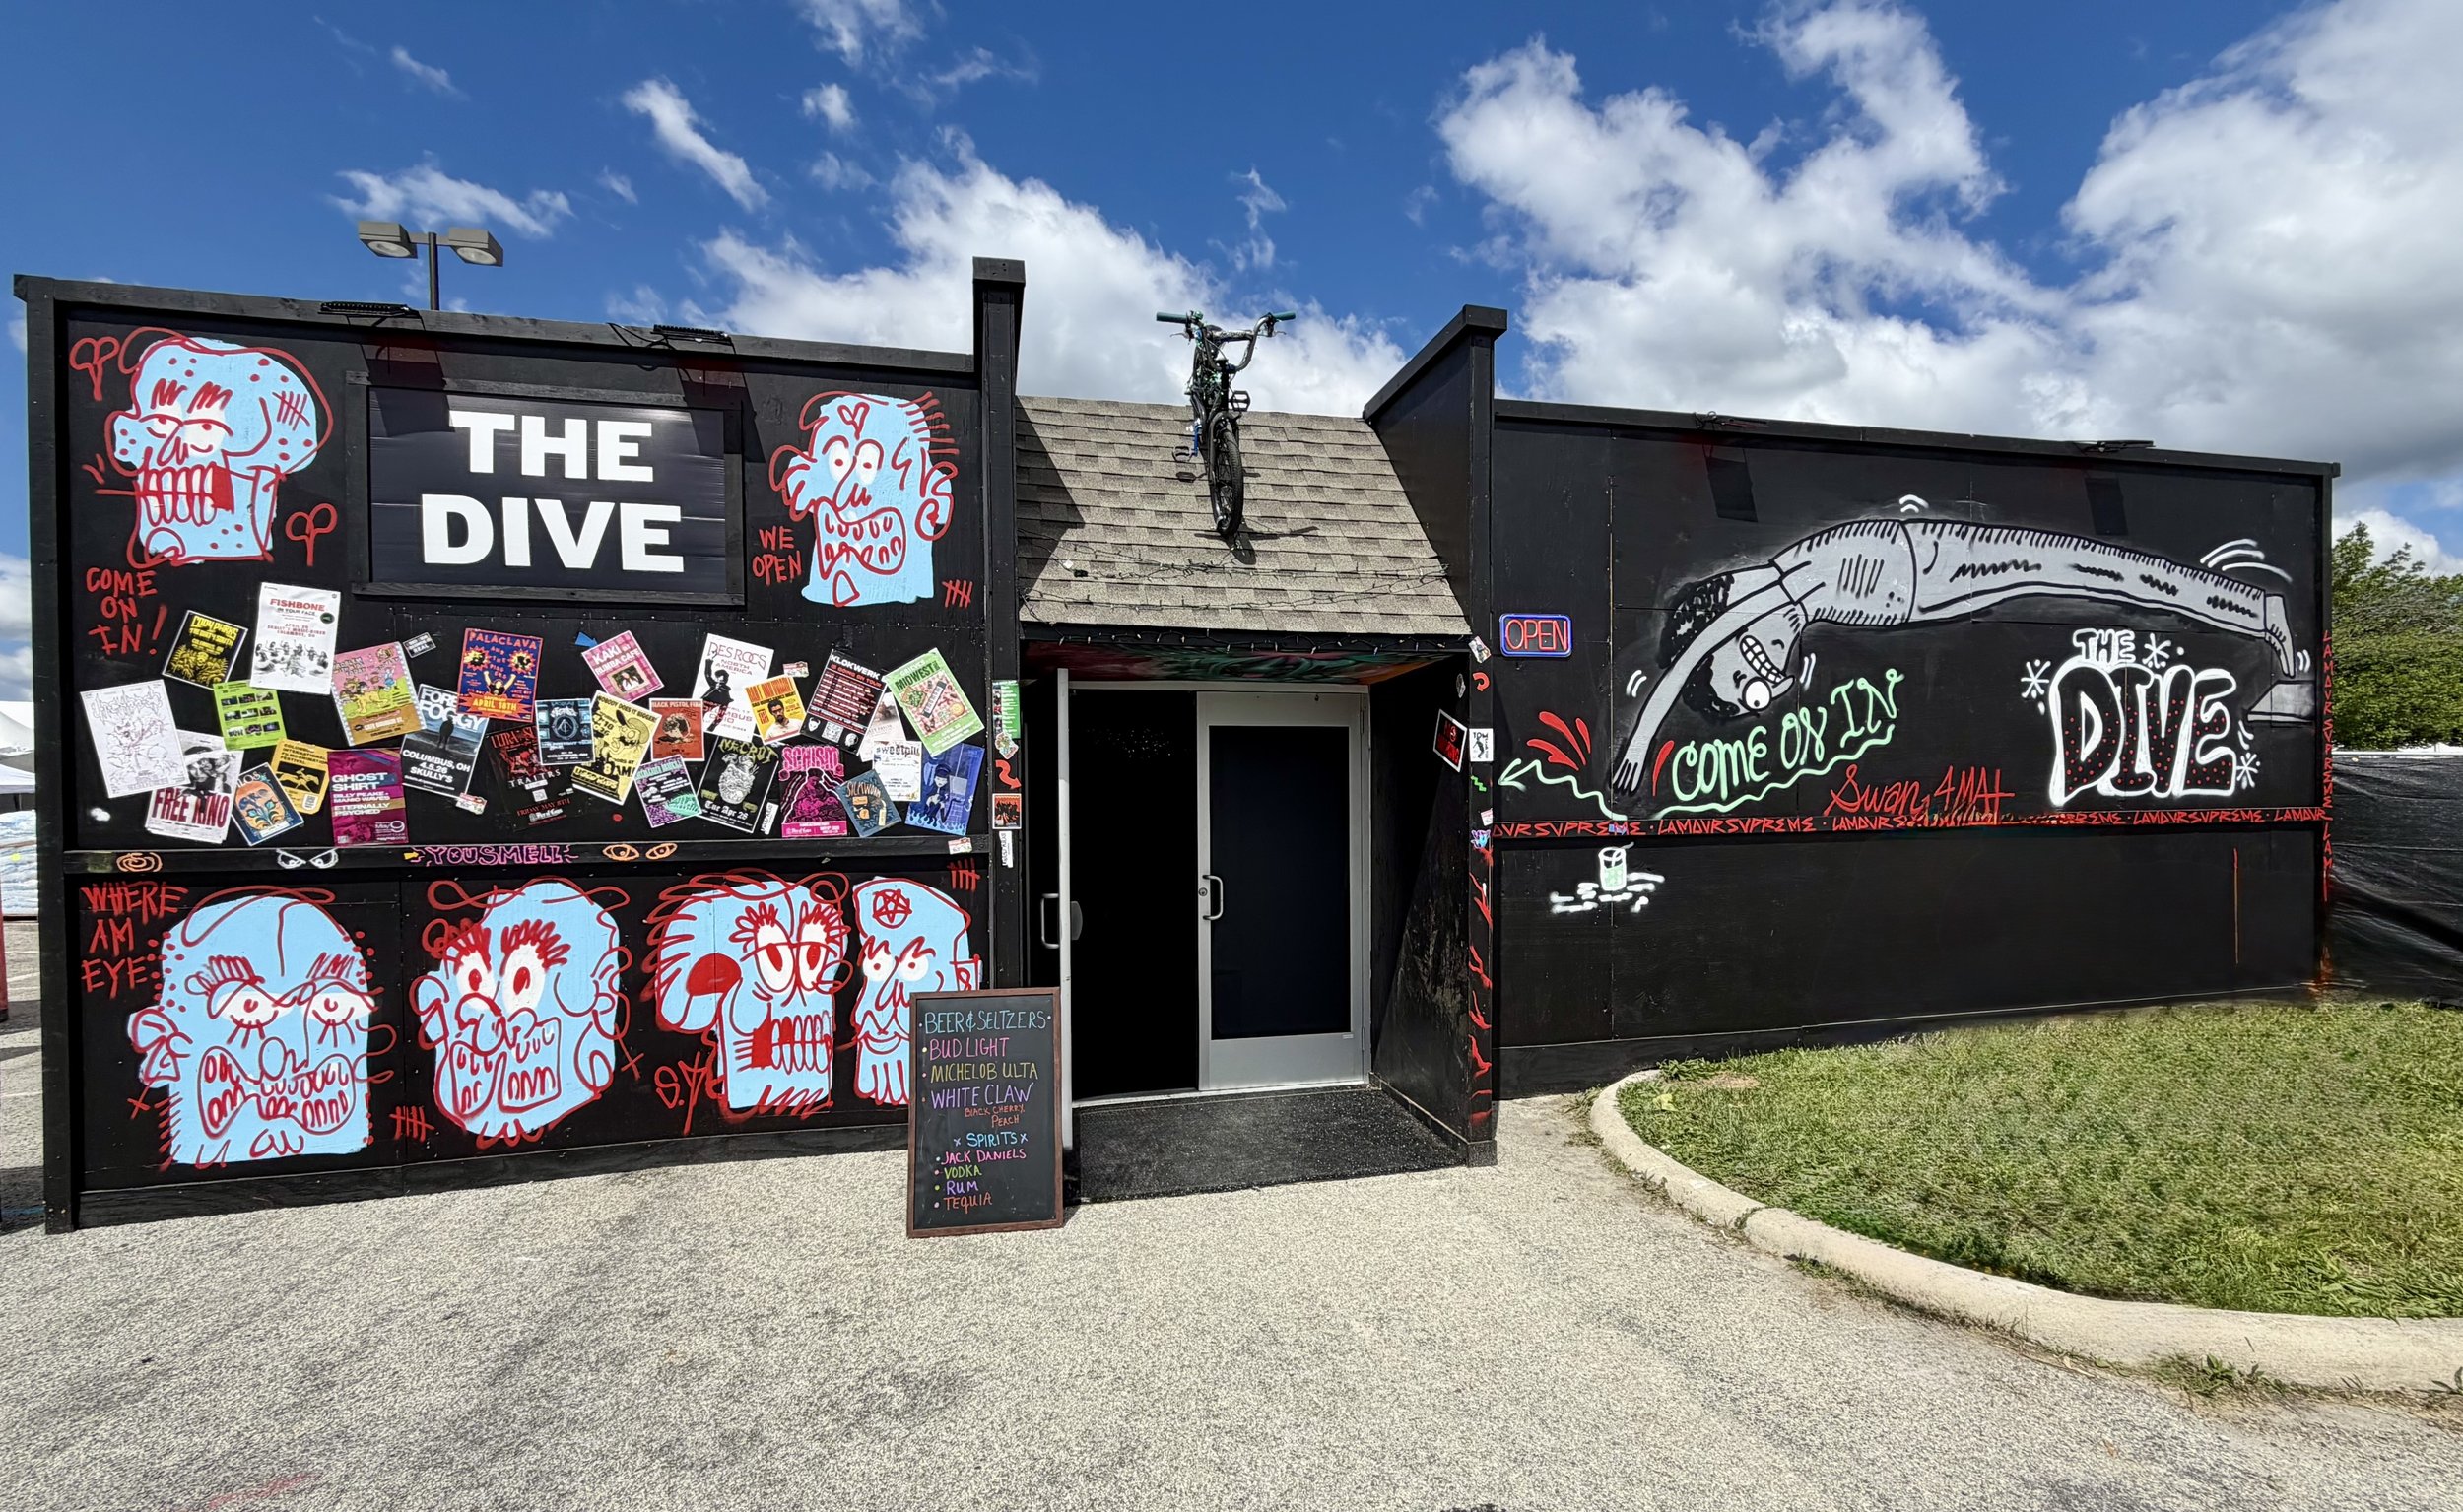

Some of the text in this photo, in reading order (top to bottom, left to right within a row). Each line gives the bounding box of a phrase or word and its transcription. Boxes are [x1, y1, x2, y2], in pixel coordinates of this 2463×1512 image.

[449, 410, 653, 482] THE
[422, 494, 684, 572] DIVE
[759, 526, 794, 551] WE
[752, 551, 802, 585] OPEN
[86, 567, 158, 597] COME
[100, 596, 137, 623] ON
[269, 598, 326, 612] FISHBONE
[468, 630, 537, 650] PALACLAVA
[1505, 619, 1567, 651] OPEN
[592, 644, 622, 665] KAKI
[620, 648, 641, 663] CAFE
[2073, 628, 2136, 668] THE
[715, 663, 753, 677] AMERICA
[720, 659, 750, 671] NORTH
[830, 654, 881, 680] KLOKWERK
[894, 664, 936, 691] MIDWEST
[472, 698, 496, 709] APRIL
[669, 700, 689, 709] PISTOL
[418, 700, 485, 731] FOGGY
[1672, 669, 1904, 801] COME ON IN
[2049, 656, 2237, 806] DIVE
[280, 756, 305, 765] FESTIVAL
[402, 749, 471, 773] COLUMBUS, OH
[782, 744, 840, 773] SCHISM
[331, 772, 389, 783] GHOST
[410, 766, 453, 784] SKULLY'S
[507, 768, 562, 788] TRAITRS
[331, 782, 380, 793] SHIRT
[151, 787, 190, 822] FREE
[333, 802, 391, 811] ETERNALLY
[721, 805, 737, 817] Apr
[390, 820, 405, 833] 9
[81, 882, 188, 923] WHERE
[90, 918, 135, 955] AM
[924, 1009, 1046, 1034] BEER & SELTZERS
[929, 1037, 1010, 1061] BUD LIGHT
[930, 1062, 1038, 1084] MICHELOB ULTA
[930, 1082, 1034, 1109] WHITE CLAW
[992, 1104, 1026, 1115] CHERRY
[991, 1114, 1020, 1128] PEACH
[965, 1131, 1018, 1148] SPIRITS
[941, 1148, 1027, 1165] JACK DANIELS
[943, 1164, 982, 1179] VODKA
[946, 1180, 979, 1195] RUM
[943, 1192, 993, 1215] TEQUIA
